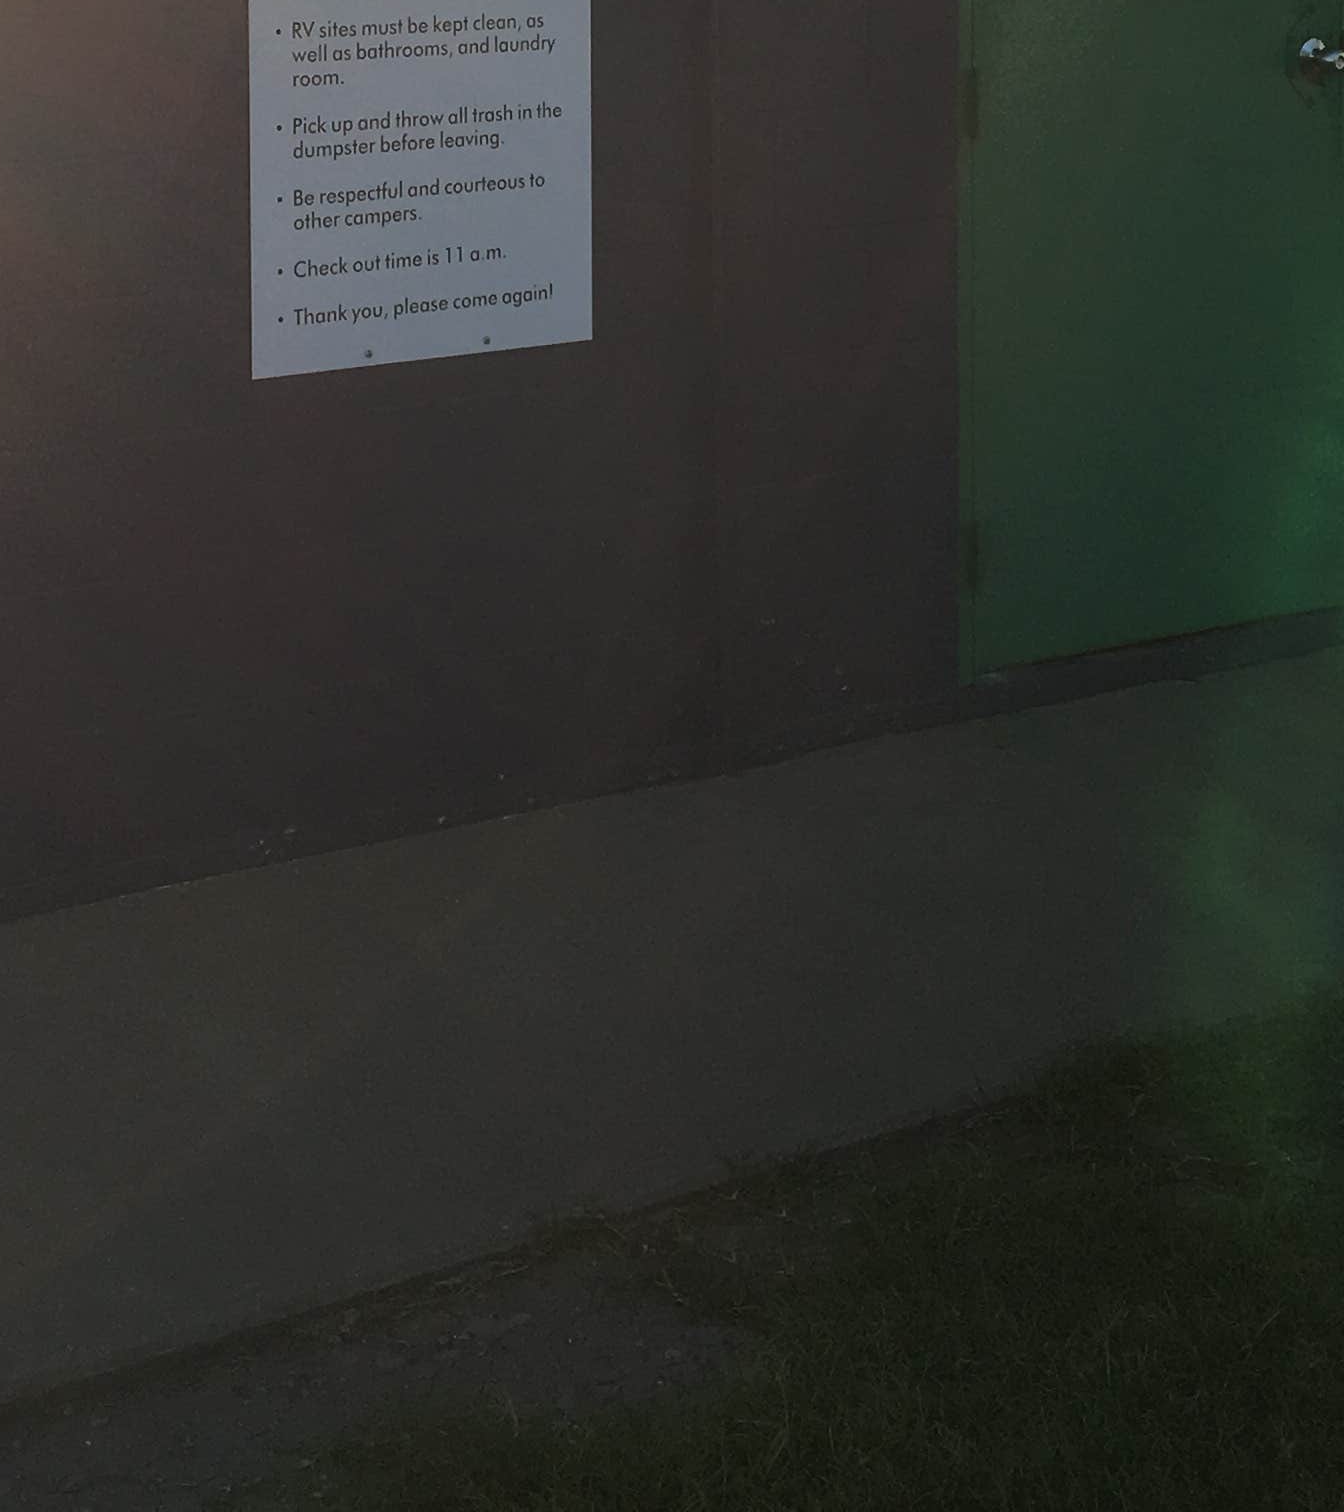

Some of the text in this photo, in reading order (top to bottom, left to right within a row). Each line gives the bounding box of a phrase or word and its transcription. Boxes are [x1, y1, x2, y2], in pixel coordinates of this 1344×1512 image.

[292, 13, 544, 39] RV sites must be kept clean, as
[292, 33, 556, 62] well as bathrooms, and laundry
[293, 73, 344, 87] room.
[293, 101, 562, 136] Pick up and throw all trash in the
[293, 129, 504, 160] dumpster before leaving.
[294, 173, 545, 207] Be respectful and courteous to
[294, 209, 422, 230] other campers.
[294, 246, 506, 277] Check out time is 11 a.m.
[293, 283, 552, 325] Thank you, please come again!
